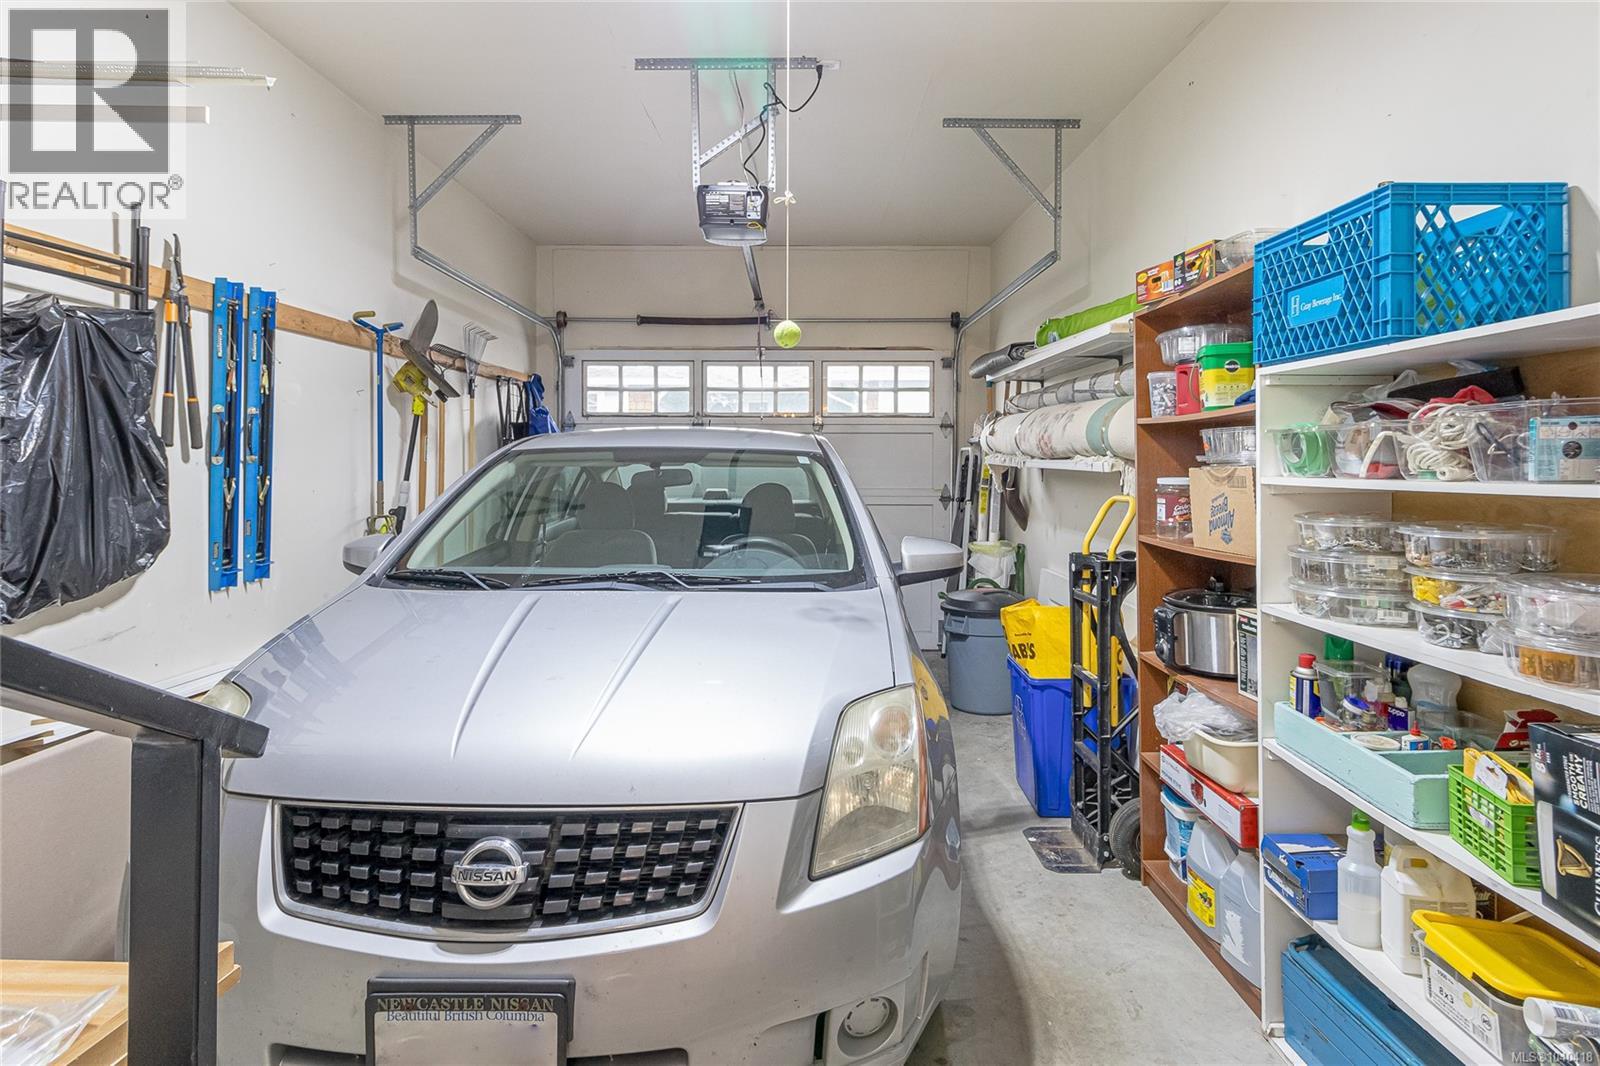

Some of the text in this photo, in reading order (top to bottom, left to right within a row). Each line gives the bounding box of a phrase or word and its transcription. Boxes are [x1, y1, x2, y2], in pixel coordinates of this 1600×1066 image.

[1008, 642, 1036, 660] AB'S
[1568, 762, 1580, 806] SMOOTH
[1573, 754, 1588, 809] CREAMY
[458, 870, 517, 882] NISSAN
[377, 997, 484, 1011] NEWCASTLE
[387, 1010, 545, 1022] Beautiful British Columbia
